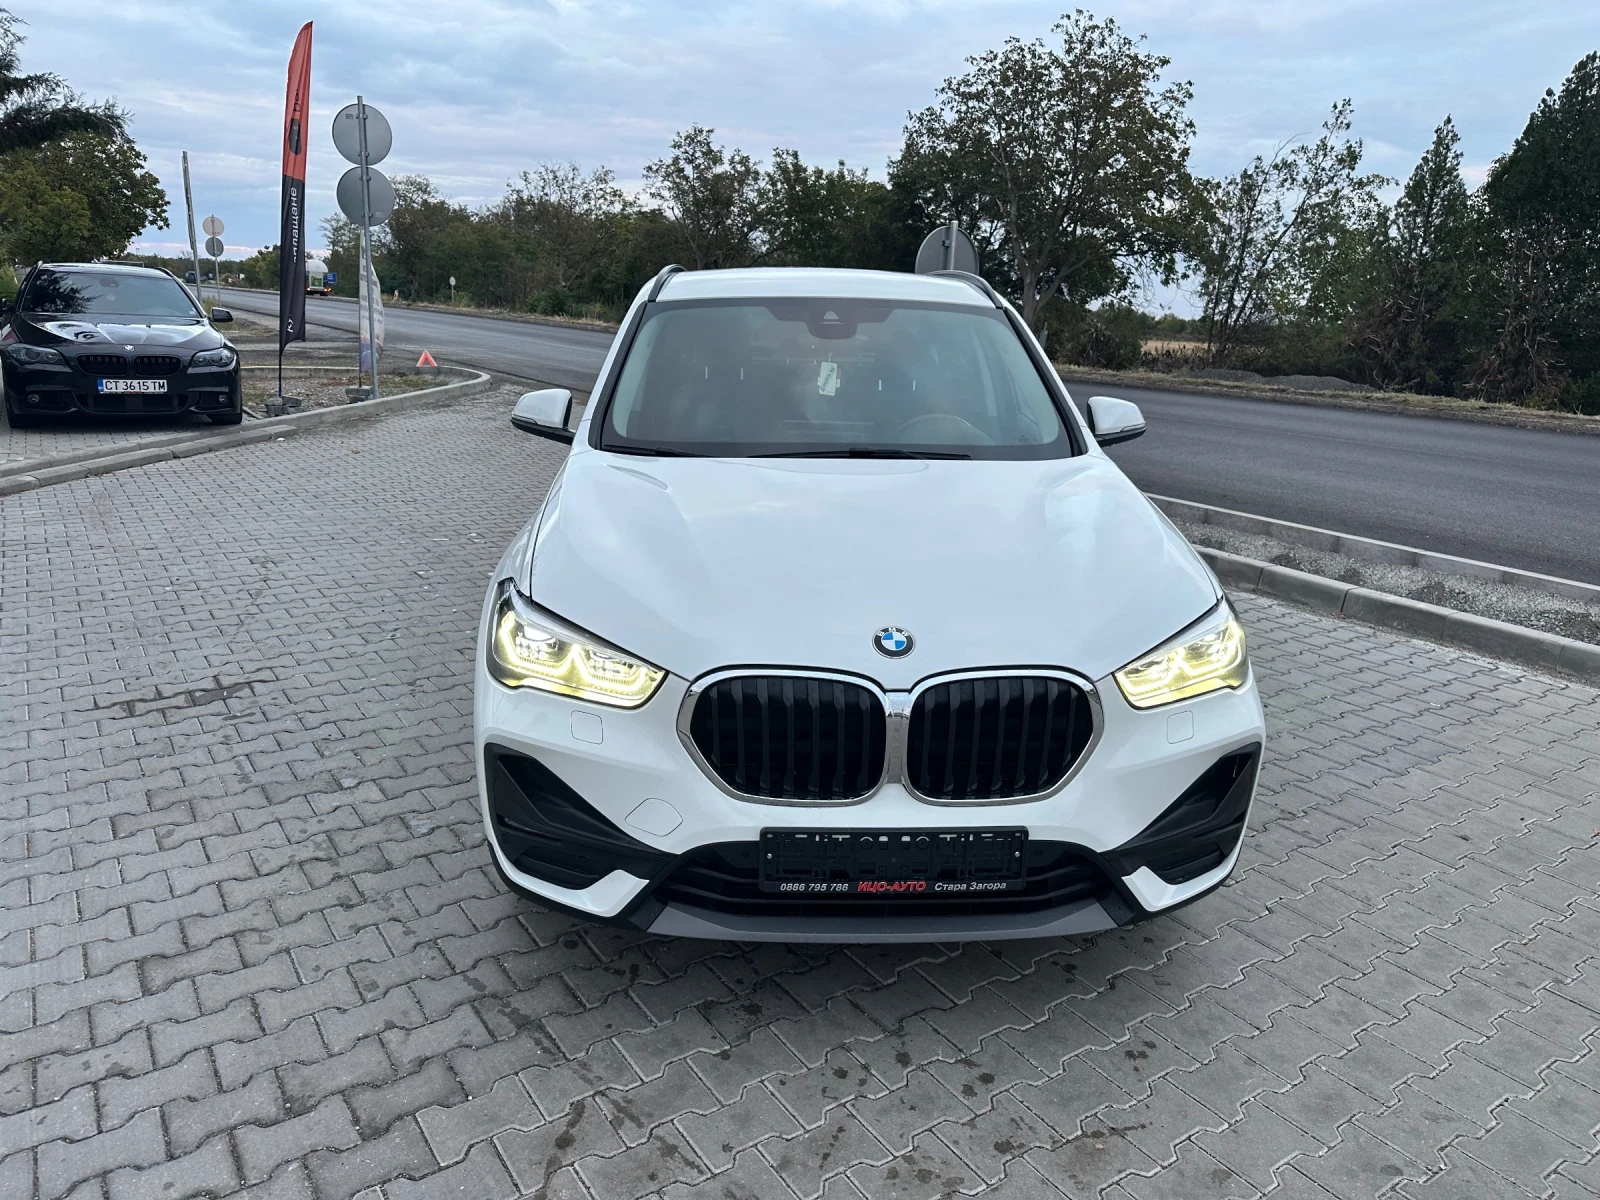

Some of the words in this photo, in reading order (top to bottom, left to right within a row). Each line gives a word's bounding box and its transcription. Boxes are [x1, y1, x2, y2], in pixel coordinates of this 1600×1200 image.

[290, 187, 299, 267] плащане
[105, 380, 120, 391] CT
[122, 381, 150, 391] 3615
[151, 381, 166, 391] TM
[780, 883, 806, 892] 0886
[808, 883, 828, 892] 795
[830, 883, 849, 892] 786
[857, 881, 927, 893] ИЦО-АУТО
[934, 882, 967, 891] Стара
[969, 881, 1007, 891] Загора
